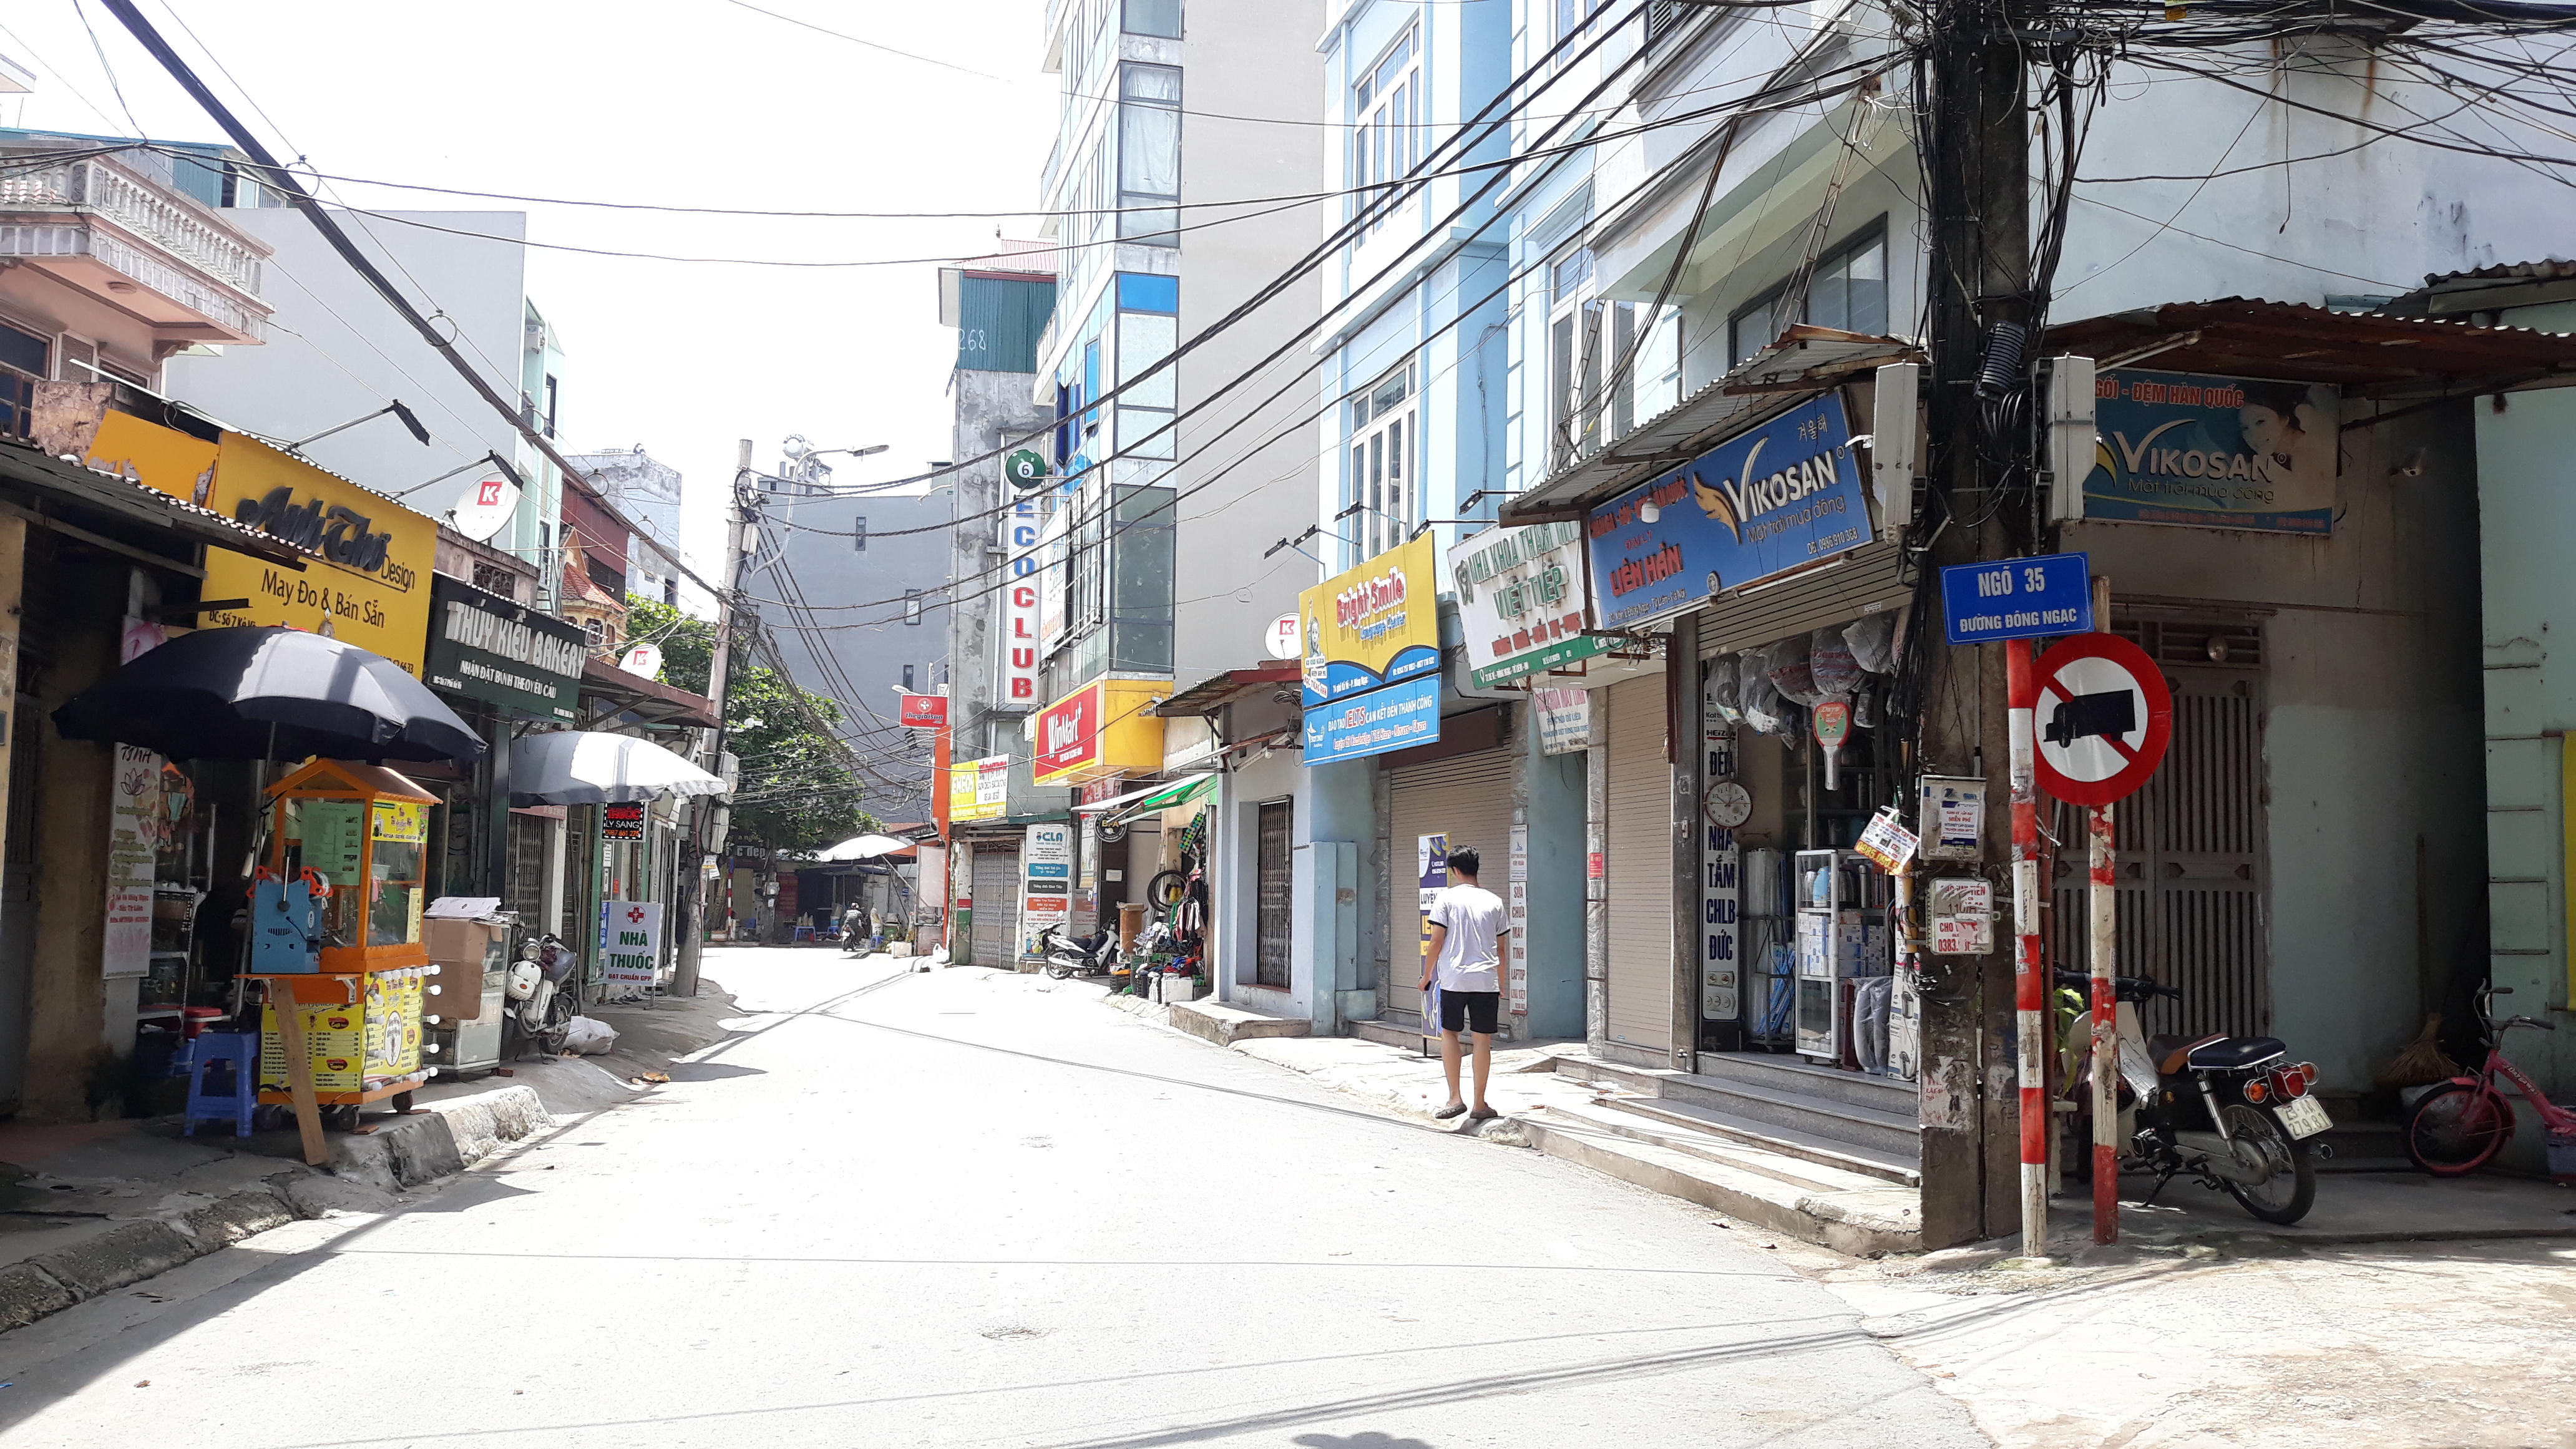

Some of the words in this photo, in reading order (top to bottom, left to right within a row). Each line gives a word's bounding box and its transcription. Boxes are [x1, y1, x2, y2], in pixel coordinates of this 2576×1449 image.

[959, 328, 987, 351] 268
[2132, 379, 2166, 406] ĐỆM
[2169, 383, 2201, 406] HÀN
[2203, 383, 2245, 409] QUỐC
[2112, 418, 2274, 483] VIKOSAN
[1021, 464, 1030, 476] 6
[1722, 436, 1839, 523] VIKOSAN
[1813, 495, 1846, 519] đông
[381, 554, 416, 590] Design
[1977, 565, 2013, 598] NGÕ
[2024, 567, 2046, 593] 35
[261, 568, 294, 606] May
[297, 579, 317, 607] Đo
[321, 587, 331, 613] &
[335, 592, 359, 622] Bán
[364, 599, 385, 628] Sẵn
[1336, 580, 1372, 630] Bright
[1371, 566, 1407, 615] Smile
[1959, 613, 2002, 633] ĐƯỜNG
[2004, 610, 2040, 629] ĐÔNG
[2042, 608, 2077, 627] NGẠC
[532, 630, 587, 679] BAKERY
[1345, 706, 1365, 729] IELTS
[615, 821, 640, 829] SANG
[1705, 898, 1735, 925] CHLB
[619, 929, 648, 947] NHÀ
[1939, 922, 1954, 932] CHO
[1709, 929, 1733, 961] ĐỨC
[609, 950, 655, 970] THUỐC
[2288, 1113, 2329, 1136] 279.81
